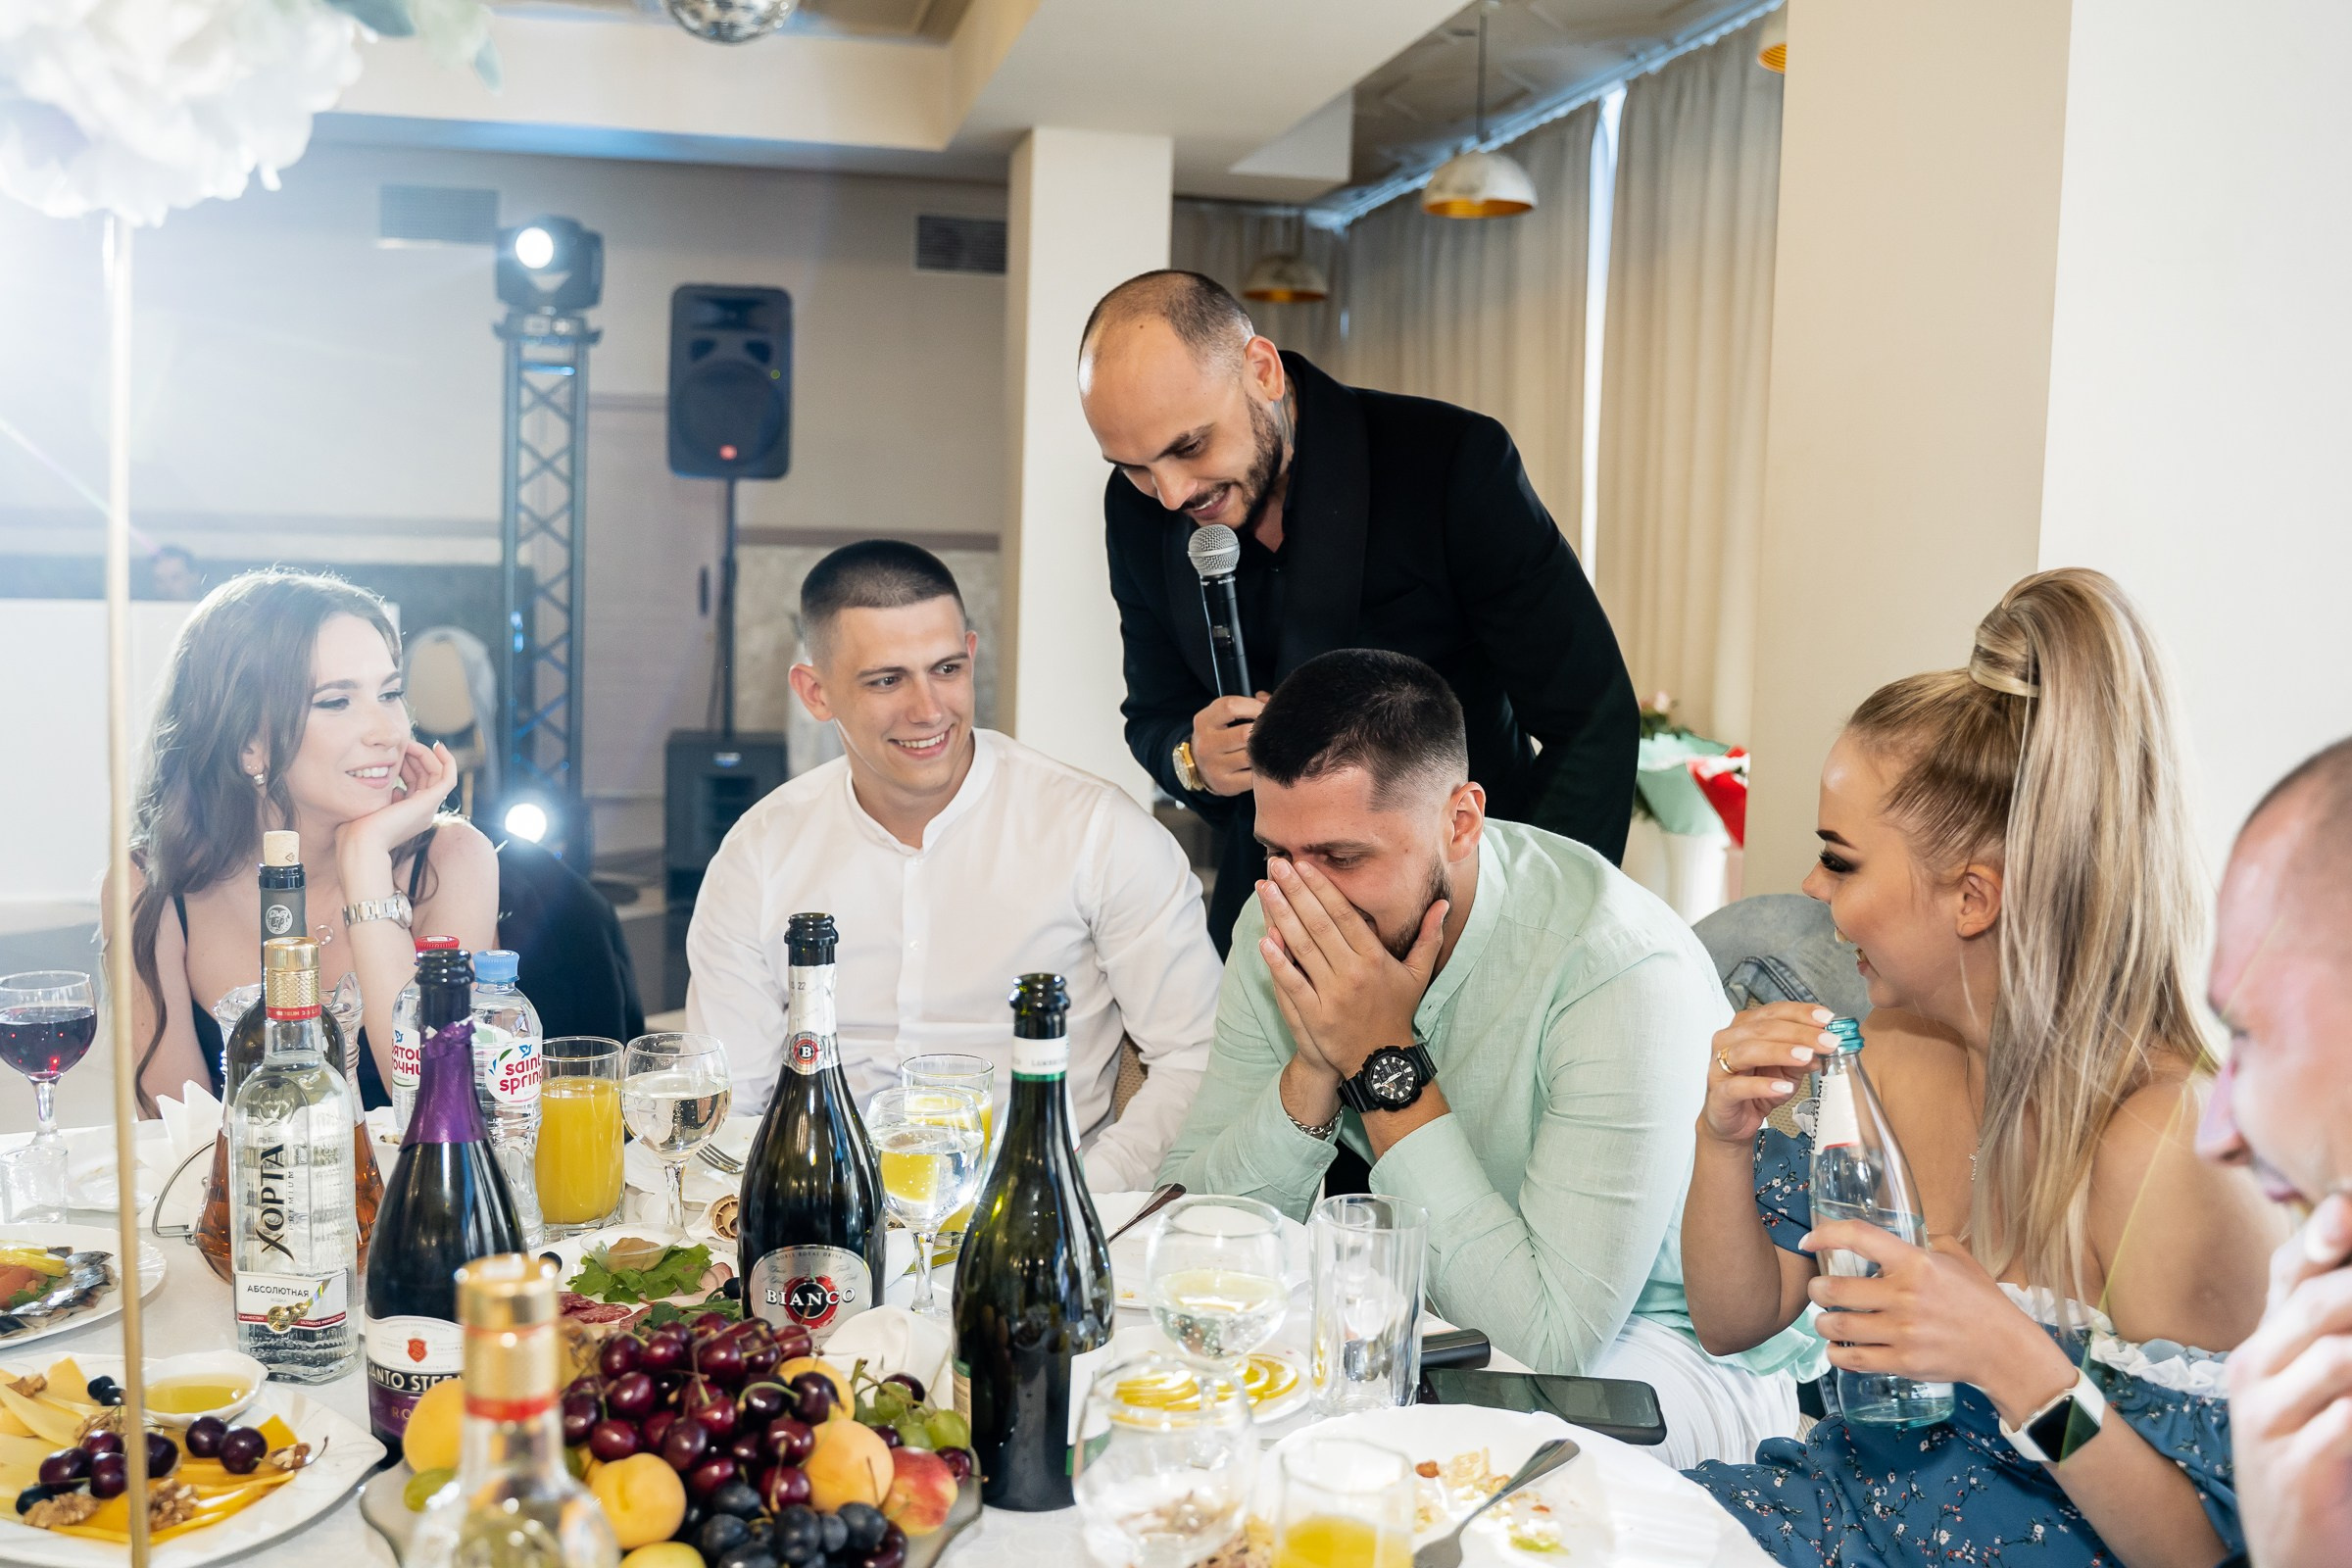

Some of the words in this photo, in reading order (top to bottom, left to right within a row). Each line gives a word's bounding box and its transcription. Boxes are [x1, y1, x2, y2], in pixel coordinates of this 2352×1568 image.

[802, 1046, 812, 1058] B
[505, 1053, 541, 1076] saint
[247, 1284, 310, 1298] АБСОЛЮТНАЯ
[765, 1287, 856, 1307] BIANCO
